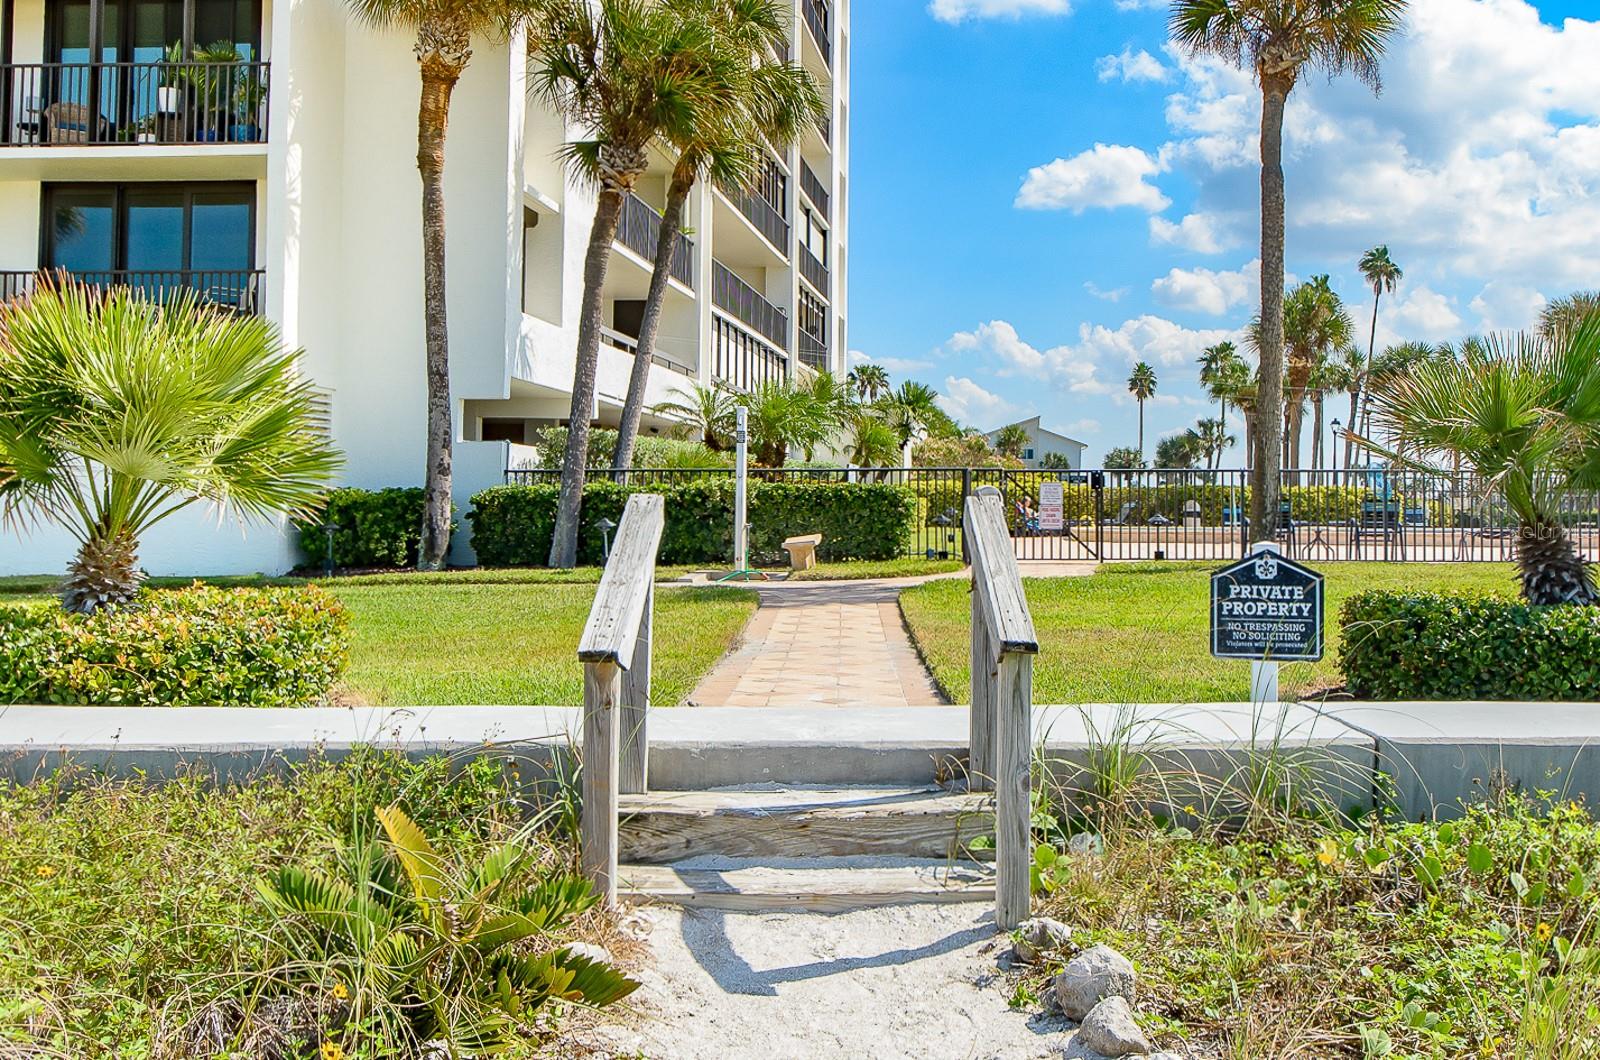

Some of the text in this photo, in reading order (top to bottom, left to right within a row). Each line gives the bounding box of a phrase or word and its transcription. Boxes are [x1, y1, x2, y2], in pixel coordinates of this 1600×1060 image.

[1229, 585, 1304, 599] PRIVATE
[1221, 601, 1312, 616] PROPERTY
[1228, 622, 1306, 632] NO TRESPASSING
[1232, 631, 1301, 641] NO SOLICITING
